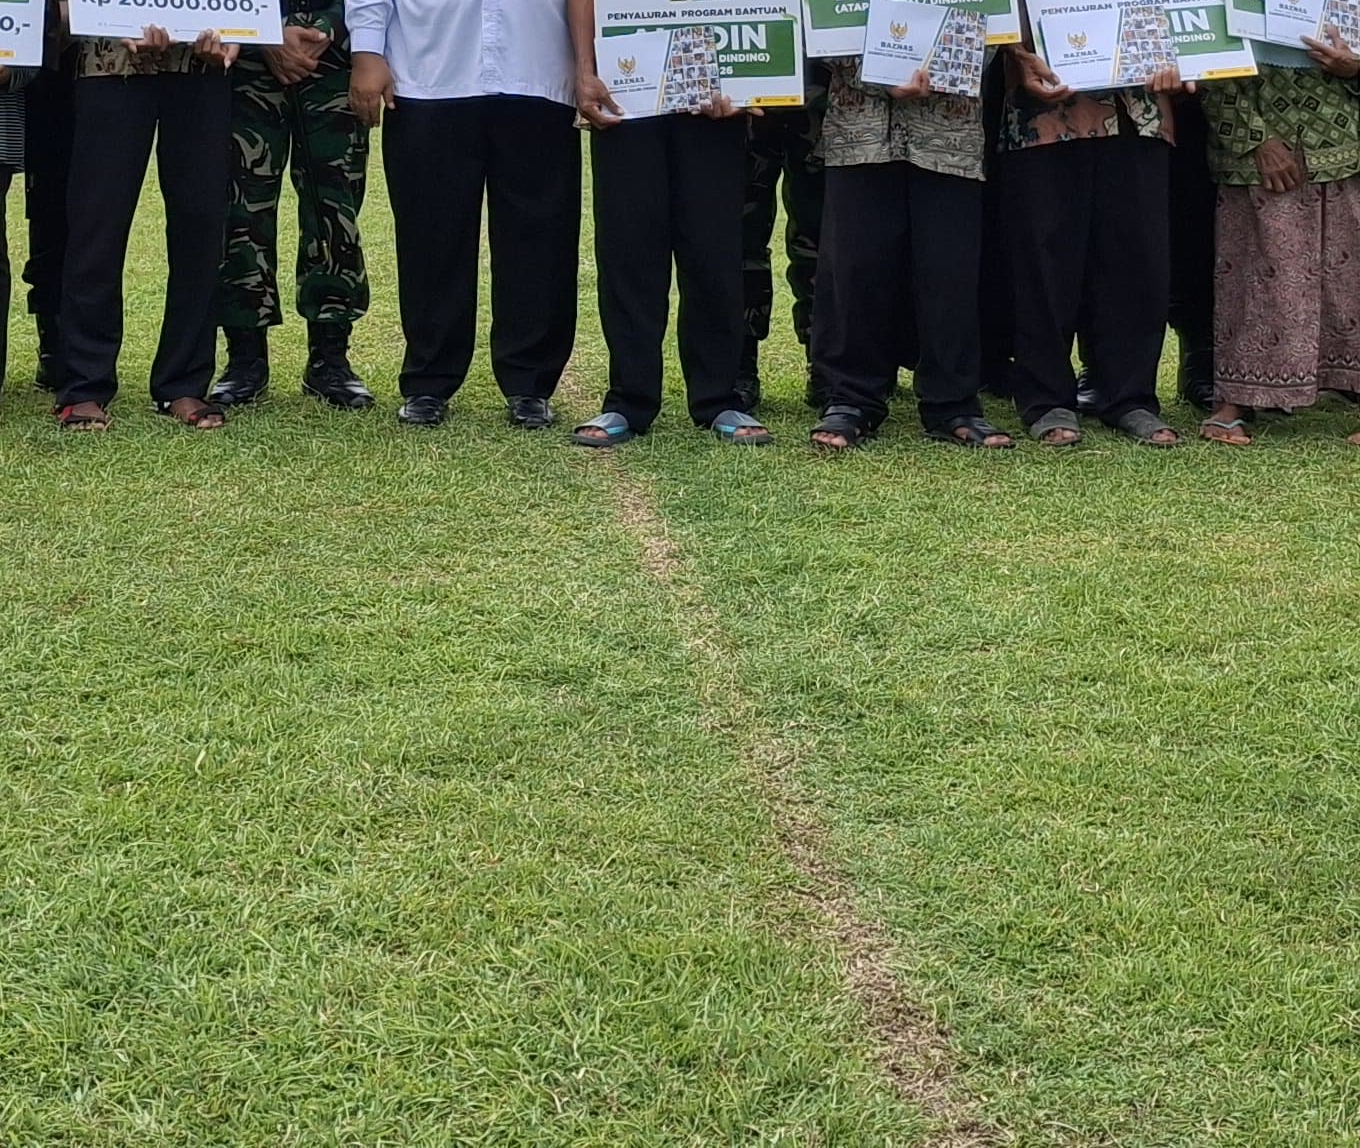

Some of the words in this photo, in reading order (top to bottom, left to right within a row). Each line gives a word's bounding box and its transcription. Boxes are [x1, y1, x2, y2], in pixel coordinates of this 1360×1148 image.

[607, 10, 677, 21] PENYALURAN
[681, 8, 733, 18] PROGRAM
[735, 6, 787, 16] BANTUAN
[1040, 3, 1113, 15] PENYALURAN
[1171, 33, 1216, 43] INDING)
[719, 52, 771, 63] DINDING)
